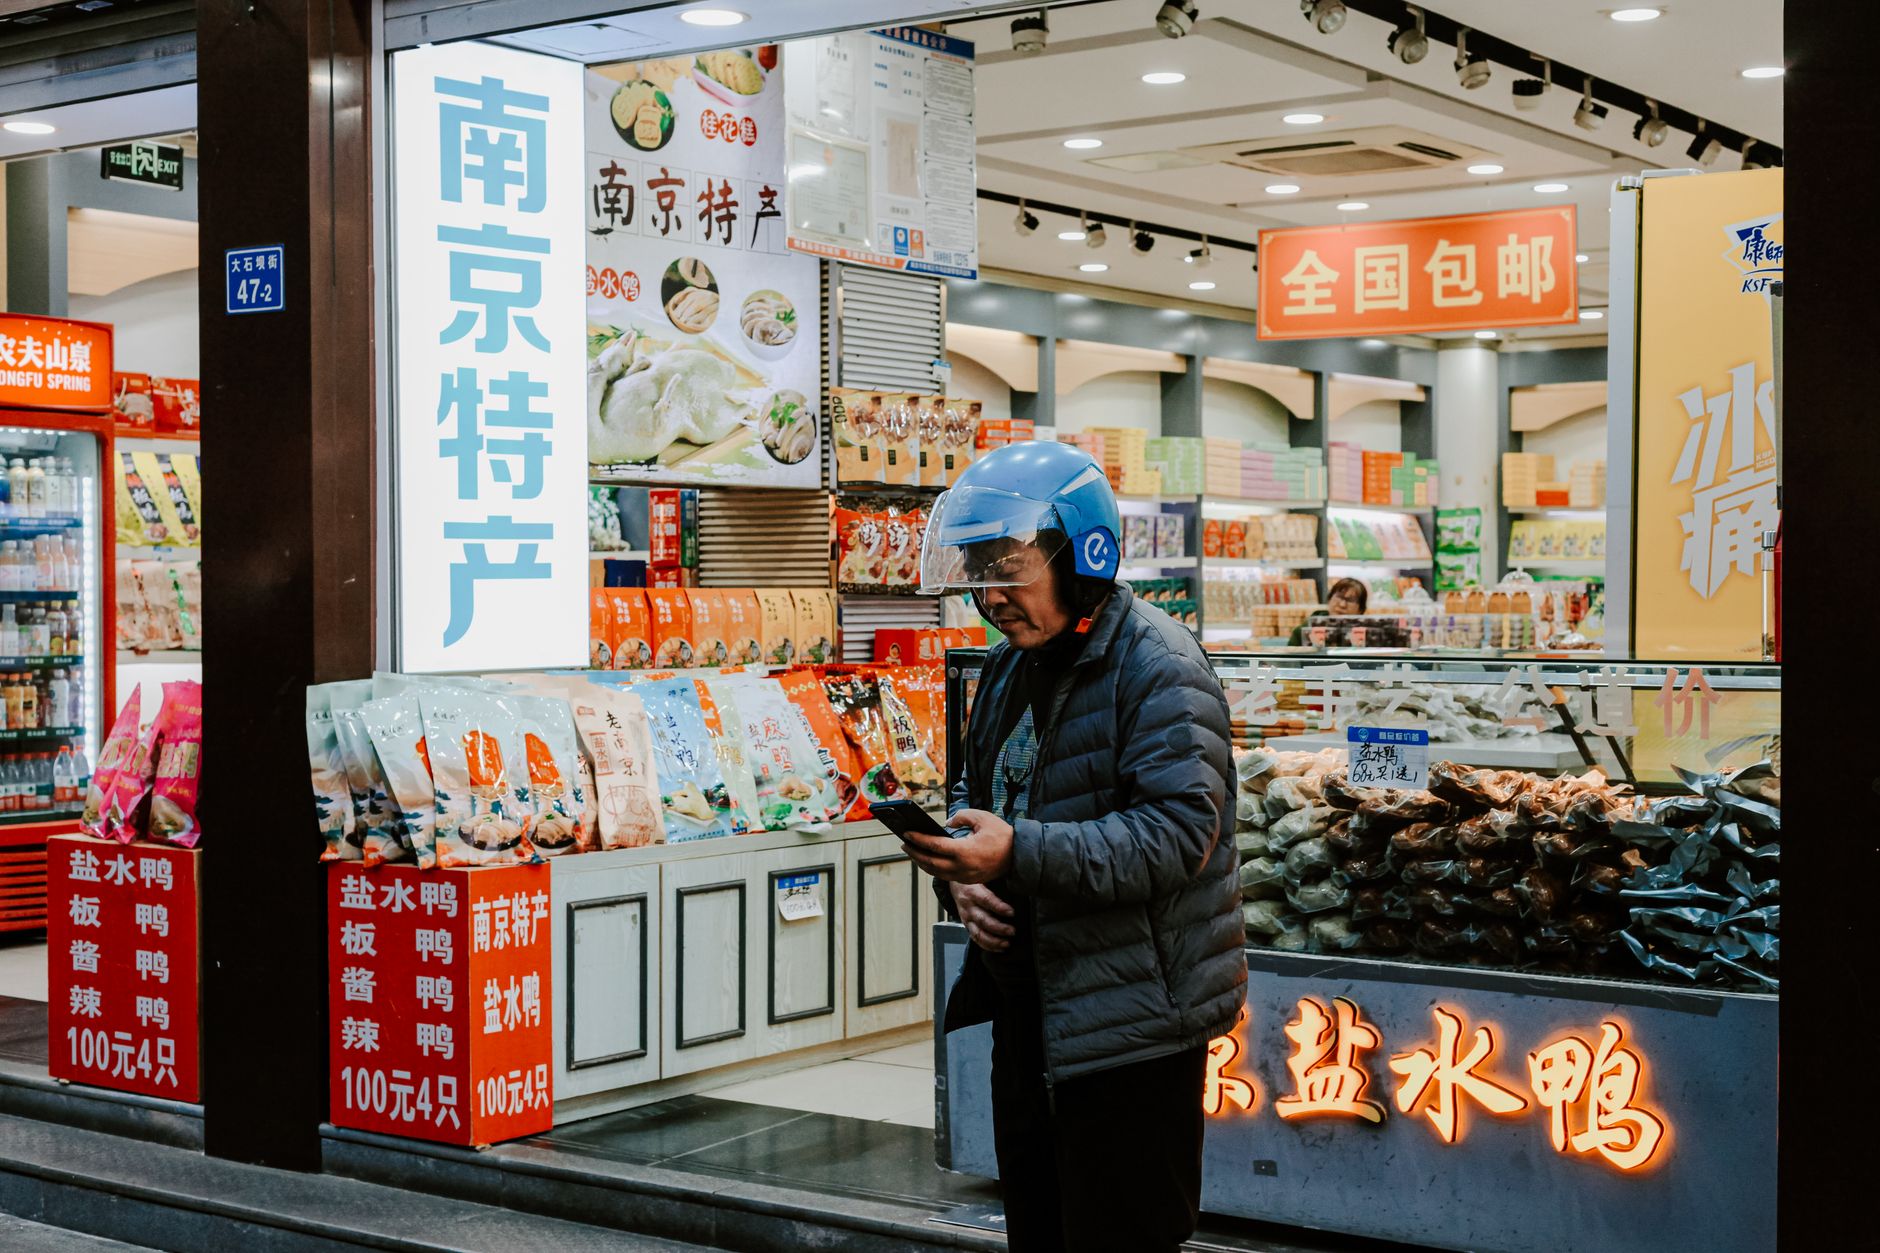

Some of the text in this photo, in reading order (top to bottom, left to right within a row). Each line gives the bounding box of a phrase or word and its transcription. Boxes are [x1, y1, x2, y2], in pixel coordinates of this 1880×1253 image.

[701, 110, 756, 144] 桂花糕
[158, 159, 178, 174] EXIT
[594, 160, 781, 248] 南京特产
[231, 254, 278, 273] 大石坝街
[1281, 233, 1555, 316] 全国包邮
[1742, 278, 1772, 293] KSF
[236, 278, 273, 304] 47-2
[0, 334, 91, 373] 农夫山泉
[434, 75, 554, 649] 南京特产
[47, 373, 91, 392] SPRING
[1493, 664, 1722, 740] 公道价
[1357, 741, 1398, 766] 盐水鸭
[68, 849, 174, 891] 盐水鸭
[69, 894, 169, 937] 板 鸭
[340, 875, 458, 918] 盐水鸭
[340, 920, 453, 965] 板 鸭
[472, 889, 549, 953] 南京特产
[69, 939, 169, 984] 酱 鸭
[70, 985, 170, 1030] 辣 鸭
[341, 966, 454, 1013] 酱 鸭
[483, 971, 541, 1034] 盐水鸭
[67, 1026, 179, 1088] 100元4只
[342, 1016, 454, 1060] 辣 鸭
[341, 1066, 461, 1131] 100元4只
[477, 1063, 550, 1118] 100元4只
